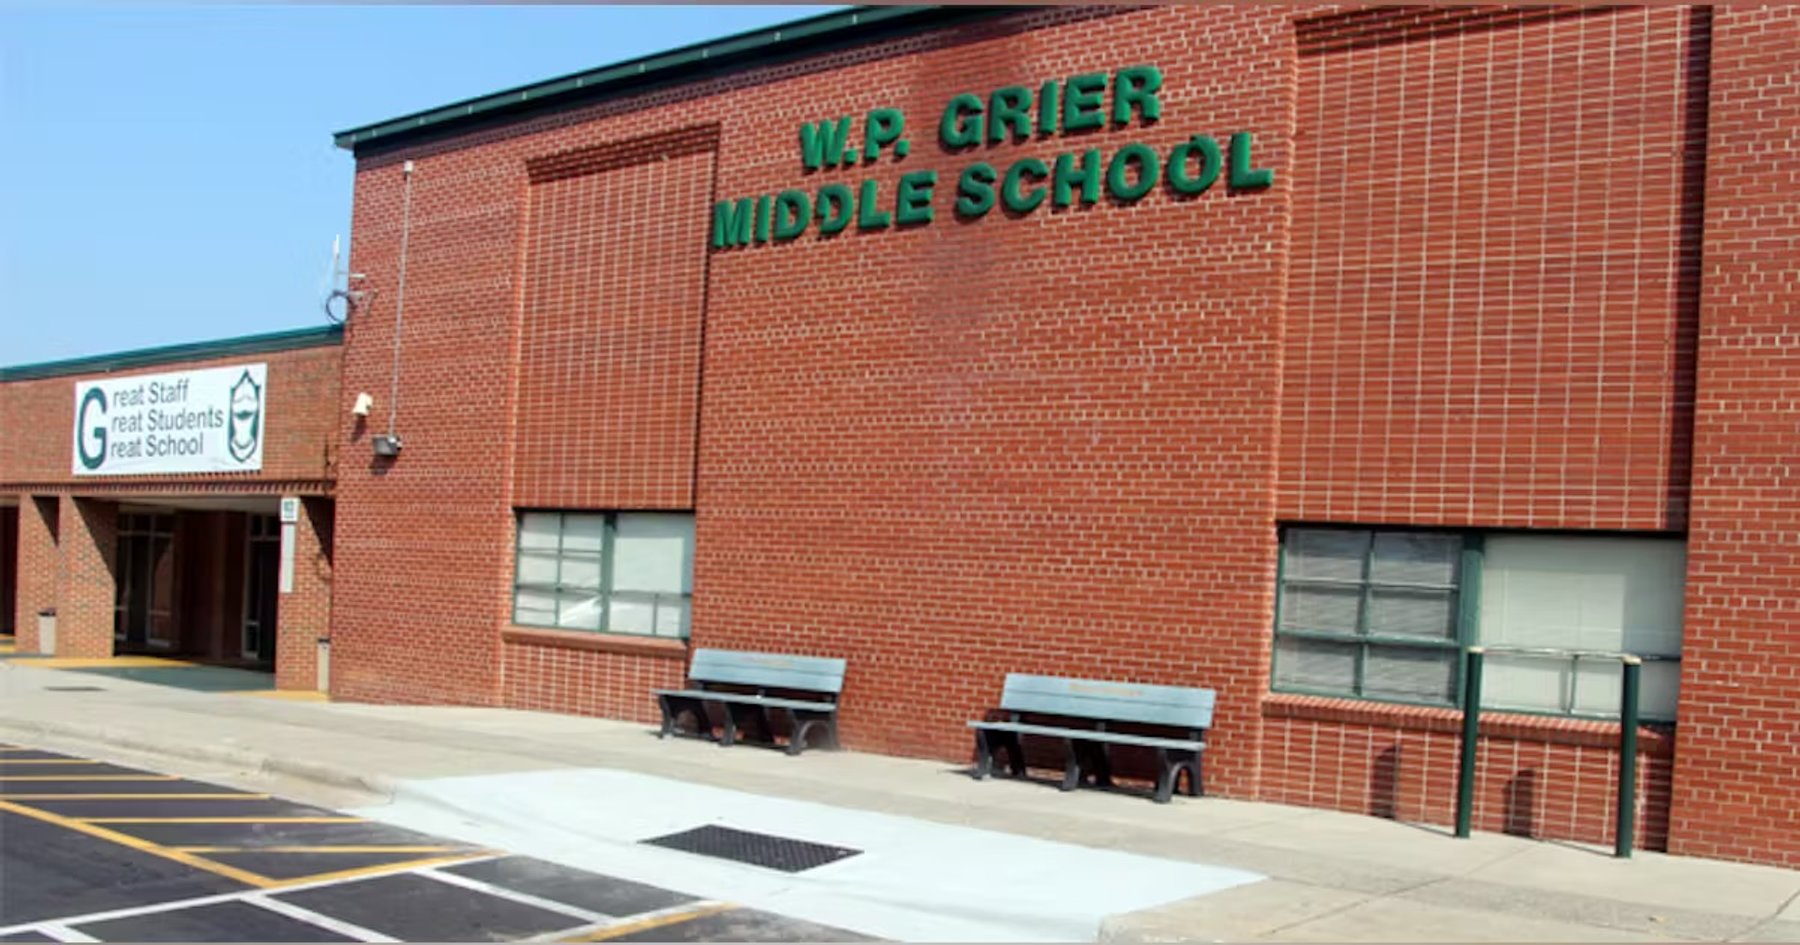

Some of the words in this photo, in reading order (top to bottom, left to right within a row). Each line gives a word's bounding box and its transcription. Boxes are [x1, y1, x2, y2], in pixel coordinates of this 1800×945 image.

[800, 106, 910, 170] W.P.
[937, 64, 1163, 151] GRIER
[712, 170, 938, 249] MIDDLE
[954, 131, 1274, 217] SCHOOL
[148, 378, 189, 405] Staff
[147, 405, 224, 433] Students
[145, 432, 204, 458] School
